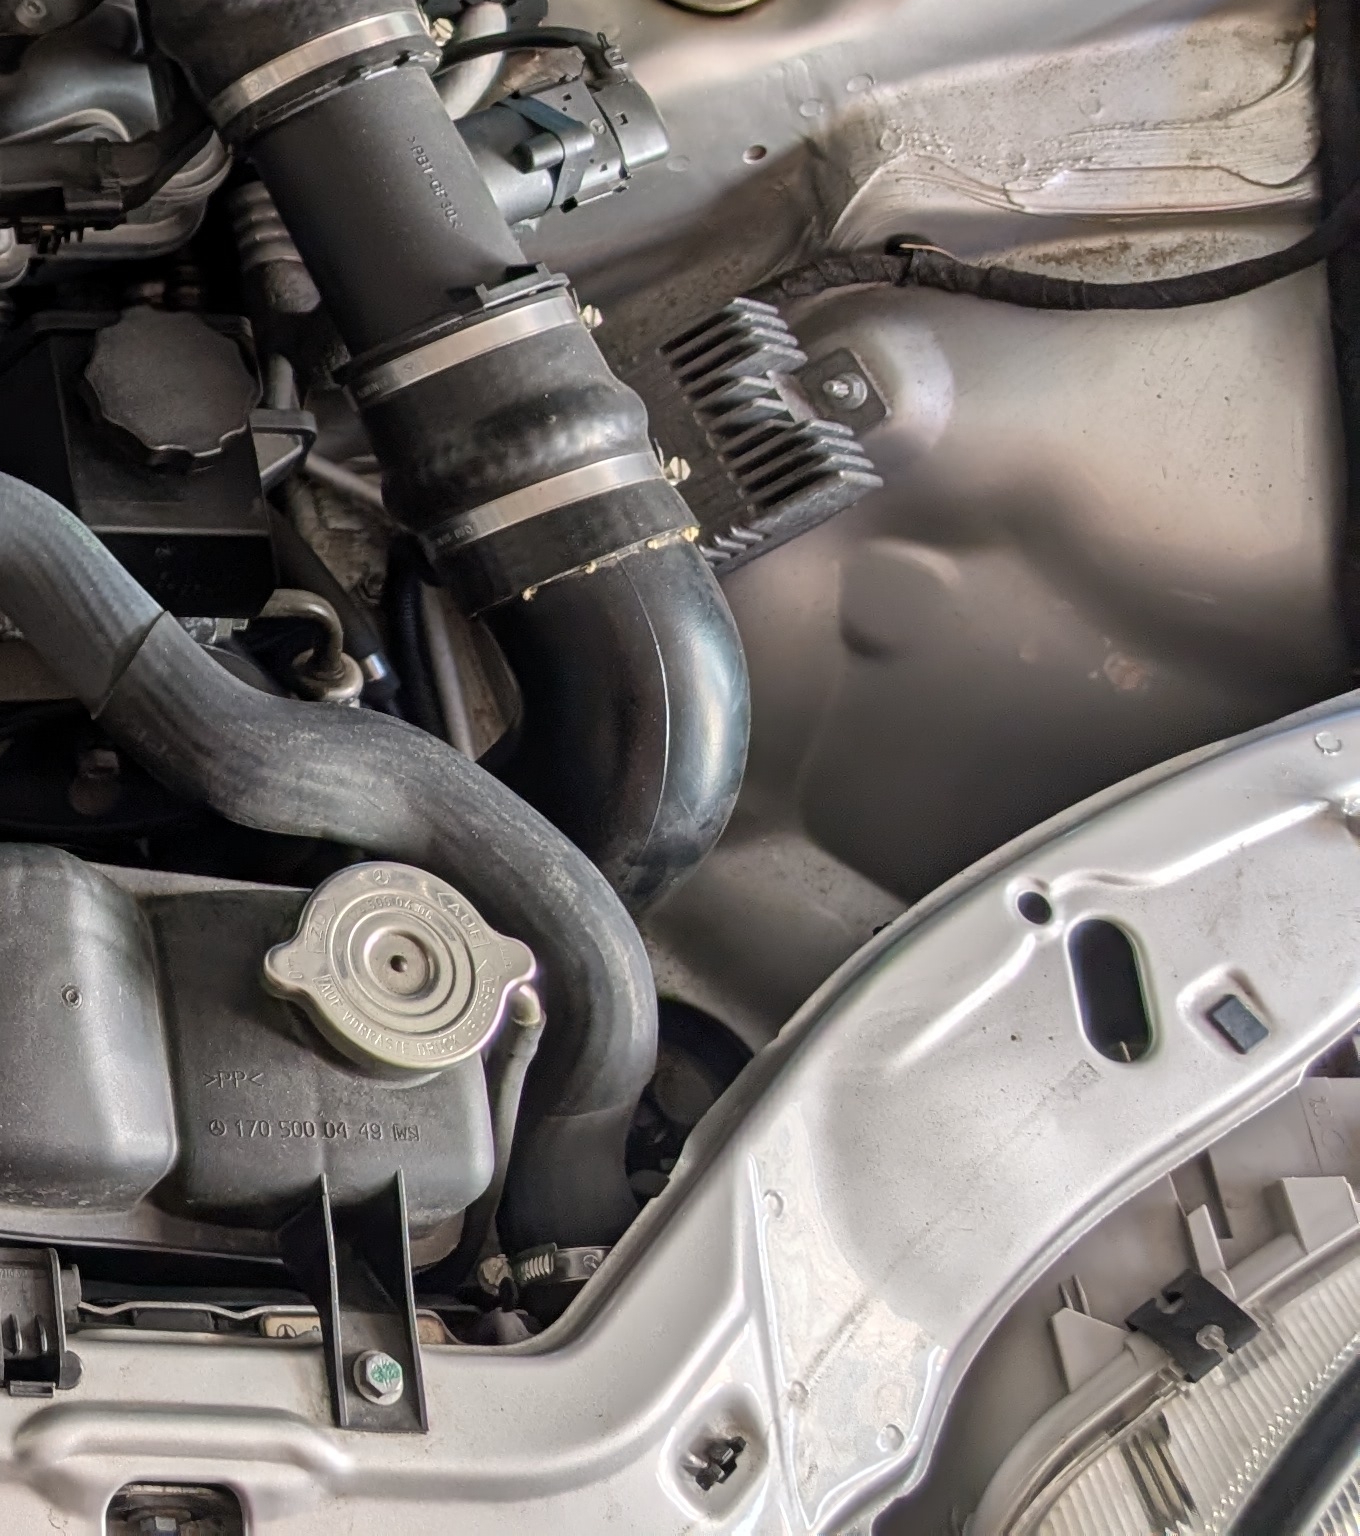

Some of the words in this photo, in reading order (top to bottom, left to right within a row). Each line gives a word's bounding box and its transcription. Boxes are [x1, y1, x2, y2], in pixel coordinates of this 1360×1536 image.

[446, 902, 484, 944] AUF
[235, 1119, 272, 1138] 170
[279, 1120, 316, 1139] 500
[358, 1121, 384, 1140] 49
